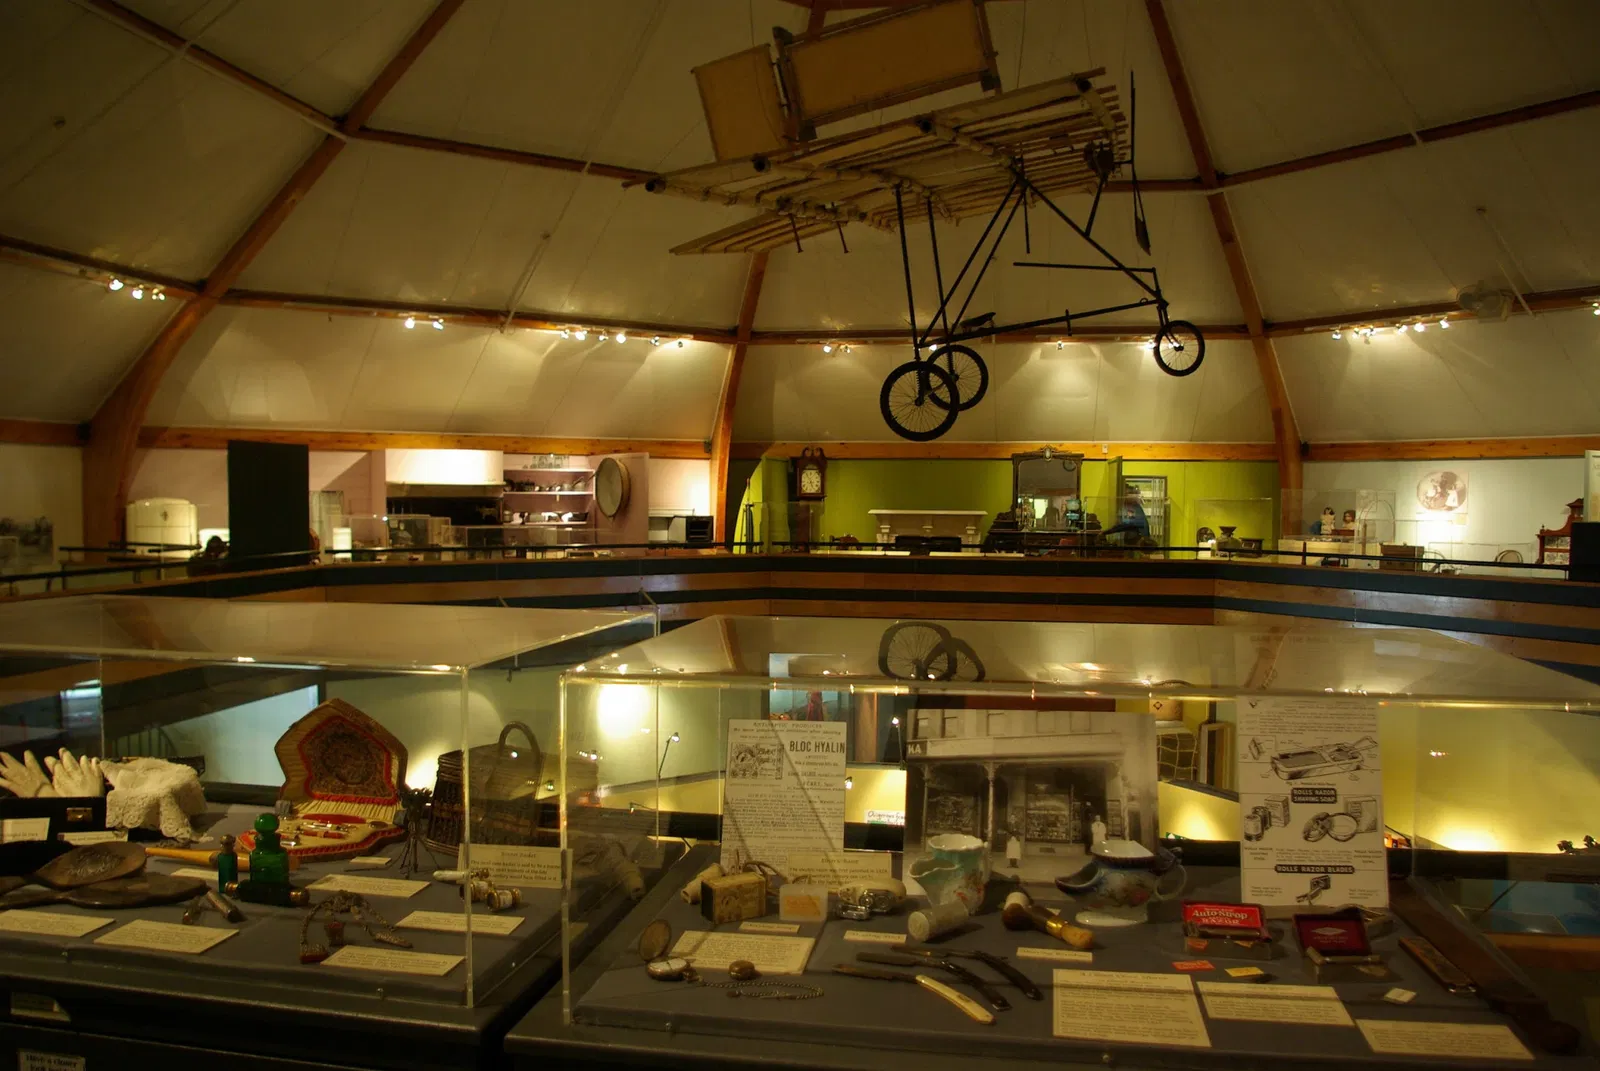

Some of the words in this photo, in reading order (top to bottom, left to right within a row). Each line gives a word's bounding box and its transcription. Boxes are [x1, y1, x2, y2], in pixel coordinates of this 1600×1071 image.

[789, 741, 812, 753] BLOC
[814, 742, 845, 755] HYALIN
[1276, 865, 1299, 873] ROLLS
[1327, 866, 1353, 874] BLADES
